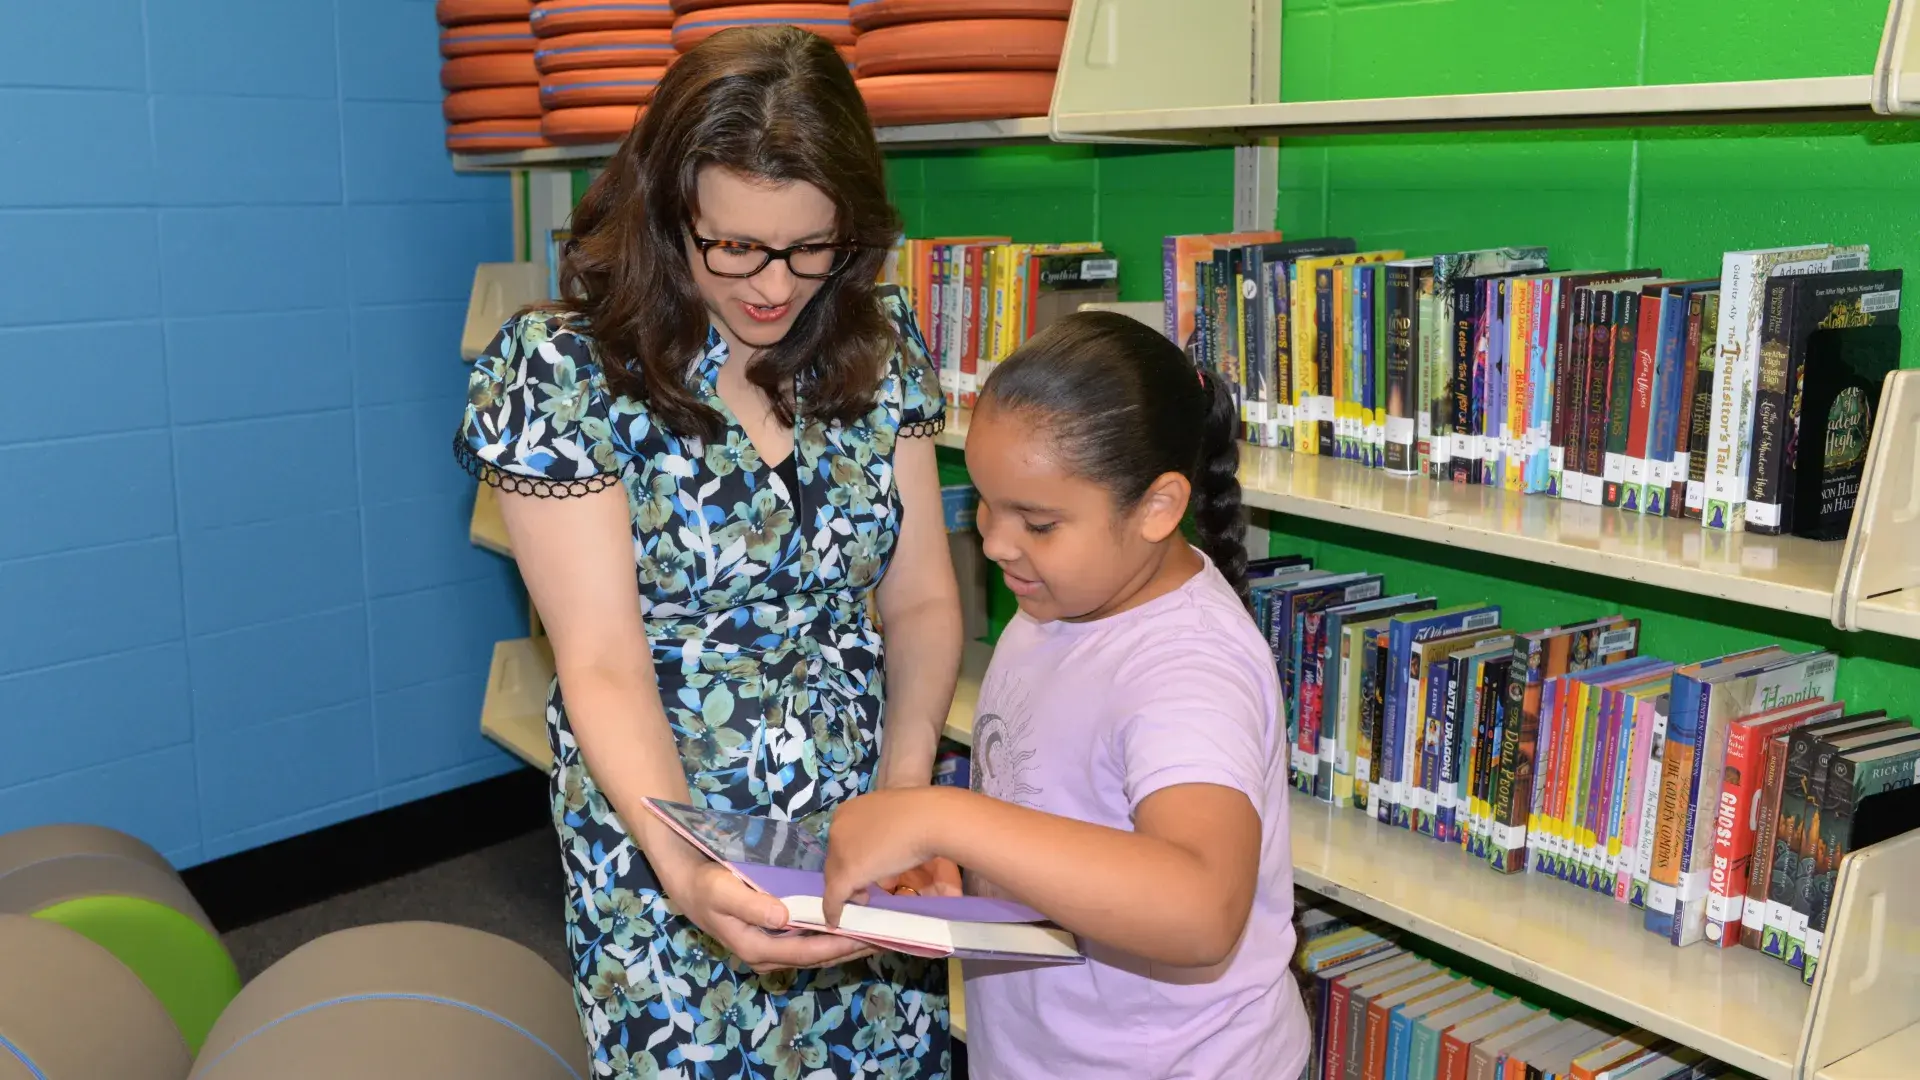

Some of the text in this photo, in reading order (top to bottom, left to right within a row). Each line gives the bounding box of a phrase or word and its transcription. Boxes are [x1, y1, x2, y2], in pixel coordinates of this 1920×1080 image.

[1041, 269, 1079, 285] Cynthia
[1780, 263, 1806, 276] Adam
[1518, 288, 1526, 315] ROALD
[1278, 314, 1288, 405] CIRCUS MIRANDUS
[1639, 349, 1651, 373] Flora
[1715, 264, 1742, 476] Gidwitz Aly The Inquisitor's Tale
[1758, 365, 1786, 377] Monster
[1763, 356, 1781, 367] High
[1515, 369, 1523, 405] CHARLIE
[1637, 377, 1650, 408] Ulysses
[1763, 374, 1780, 384] High
[1587, 361, 1605, 473] SERPENT'S SECRET
[1693, 392, 1705, 436] WITHIN
[1755, 399, 1775, 500] Legend Shadow High
[1825, 430, 1856, 456] High
[1272, 600, 1281, 621] ANNA
[1761, 681, 1821, 710] Happily
[1442, 680, 1457, 779] BATTLE DRAGONS
[1692, 693, 1707, 776] QUINDLEN STEVENSON
[1501, 729, 1518, 766] DOLL
[1767, 755, 1777, 787] RIORDAN
[1872, 766, 1898, 778] RICK
[1496, 767, 1513, 818] PEOPLE
[1658, 758, 1680, 869] THE GOLDEN COMPASS
[1681, 803, 1696, 872] Happily Ever After
[1711, 792, 1737, 898] GHOST BOYS
[1673, 909, 1681, 934] VIKING
[1820, 892, 1829, 929] LABYRINTH
